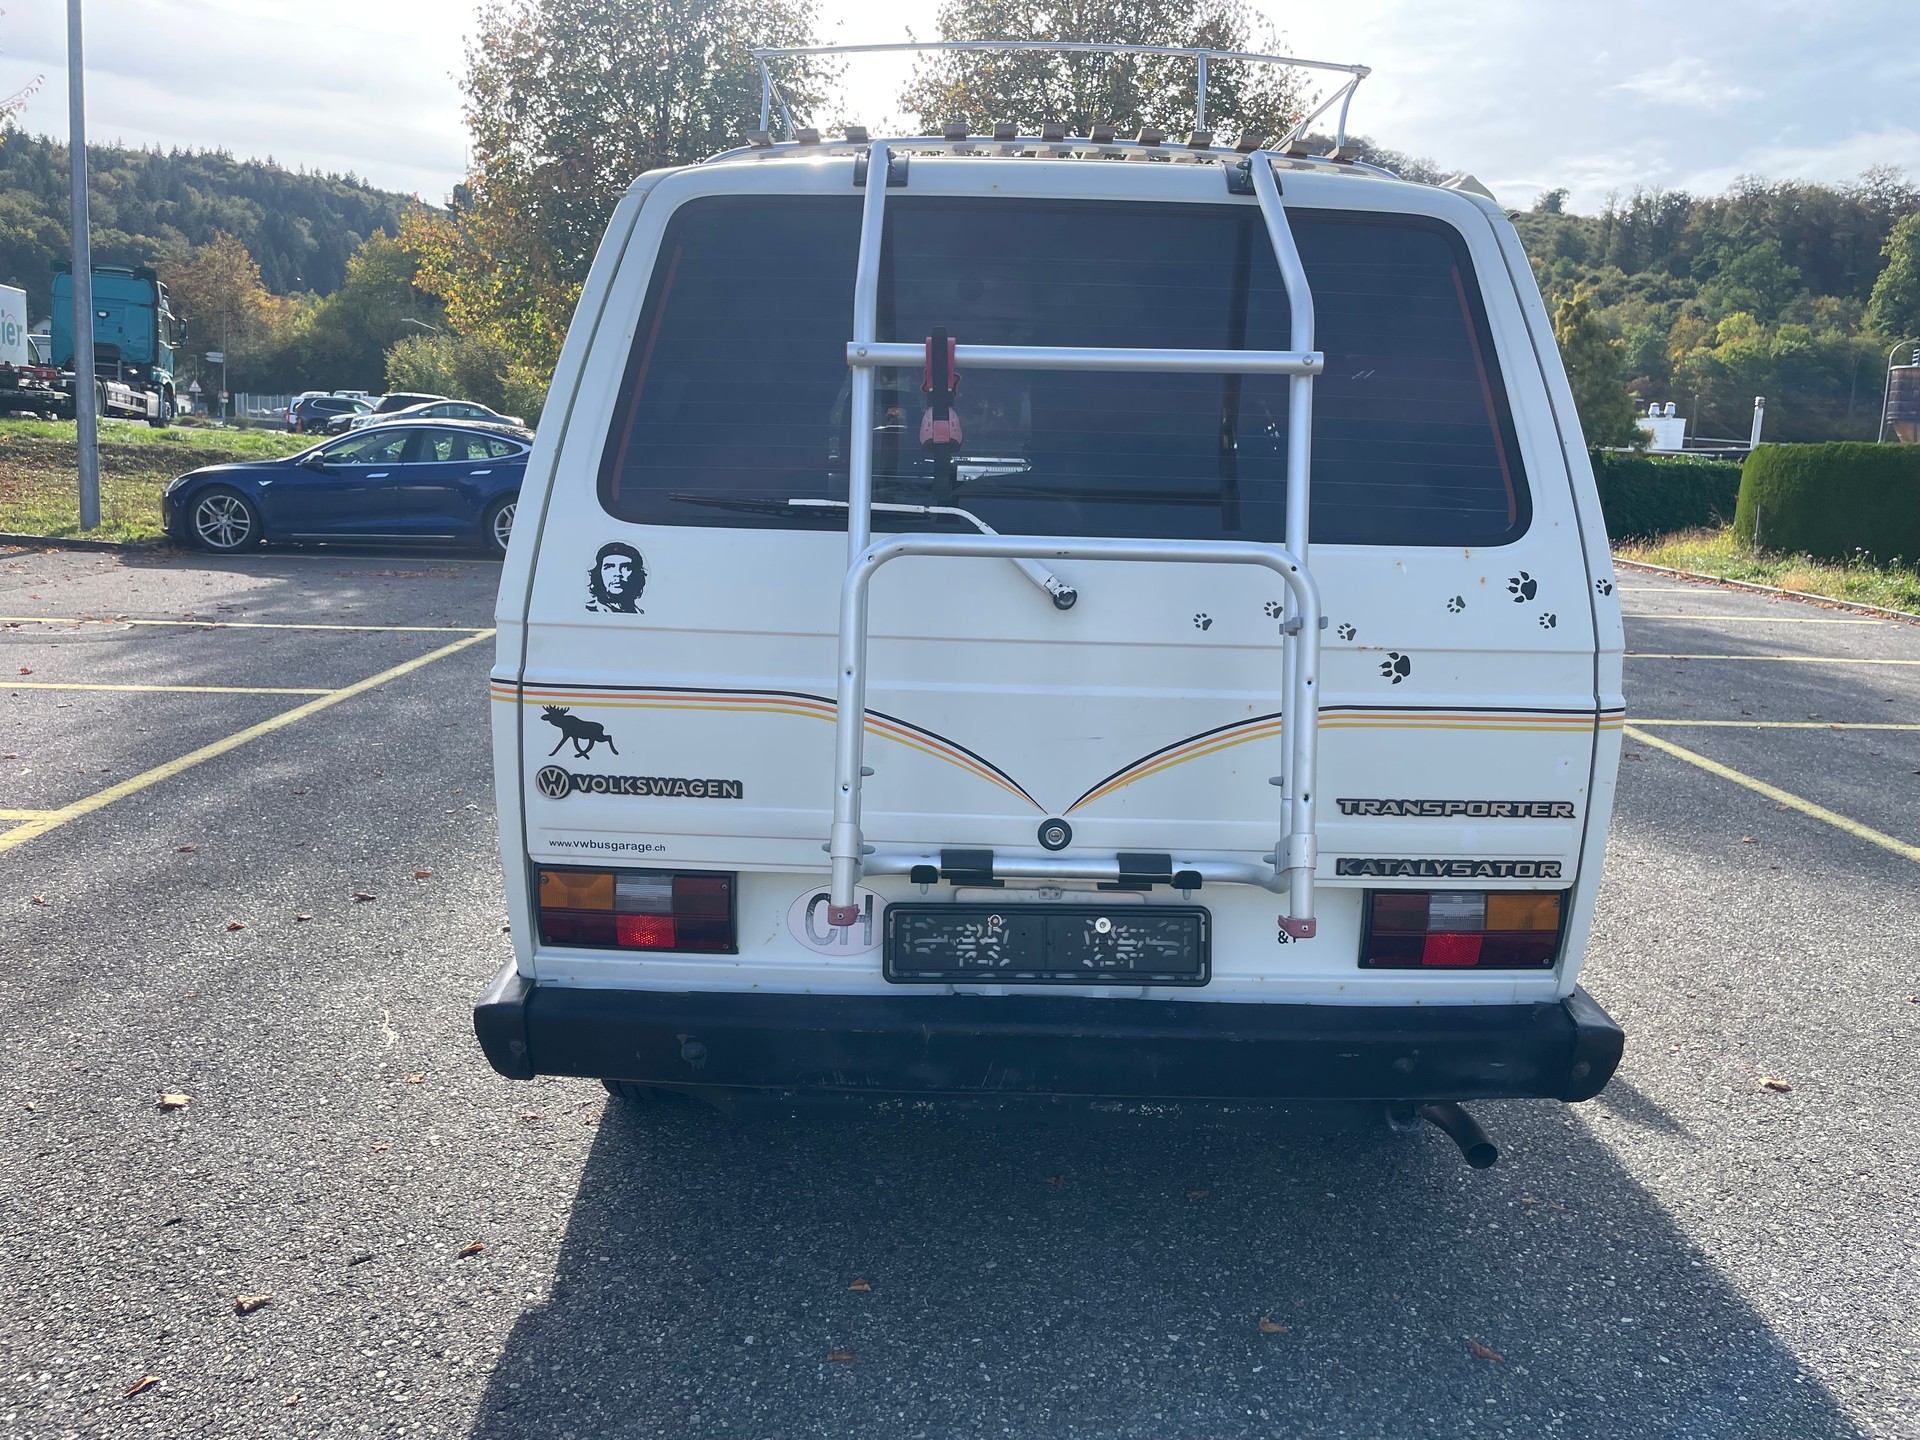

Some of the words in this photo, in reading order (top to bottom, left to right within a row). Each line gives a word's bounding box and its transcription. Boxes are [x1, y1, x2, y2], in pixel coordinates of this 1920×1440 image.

[575, 775, 739, 798] VOLKSWAGEN
[1338, 799, 1575, 818] TRANSPORTER
[548, 838, 667, 854] www.vwbusgarage.ch
[1337, 858, 1562, 877] KATALYSATOR
